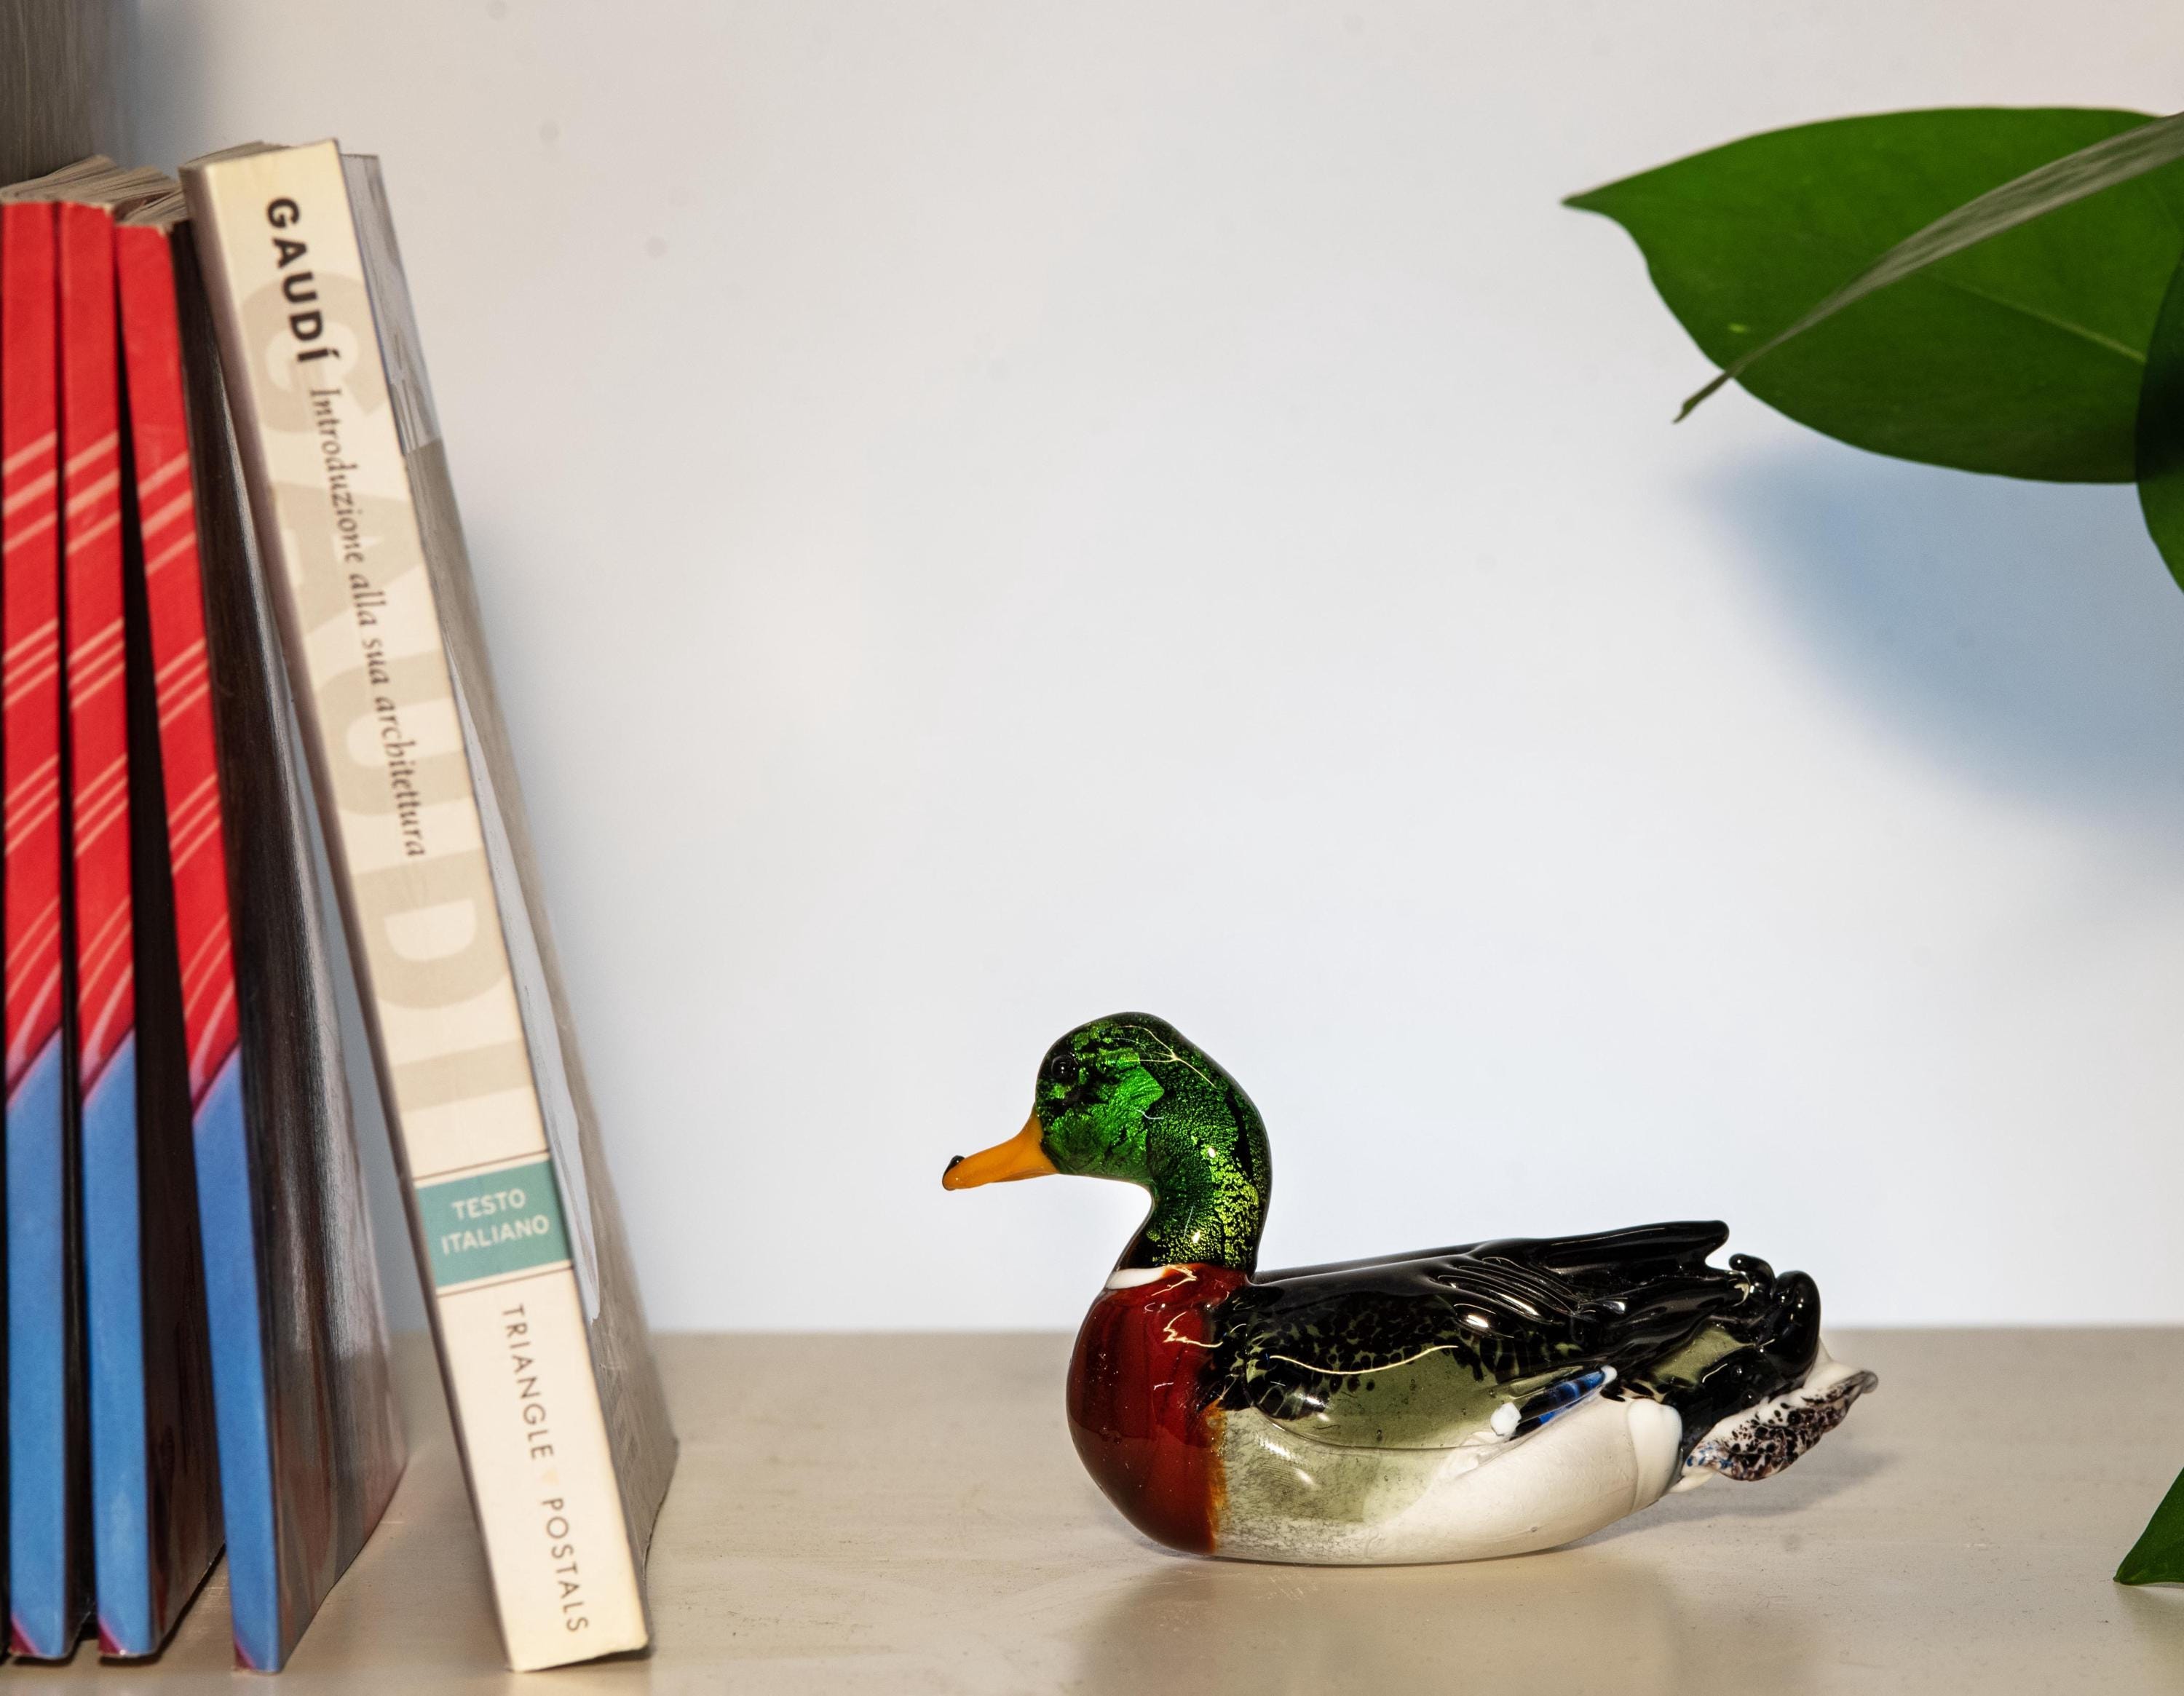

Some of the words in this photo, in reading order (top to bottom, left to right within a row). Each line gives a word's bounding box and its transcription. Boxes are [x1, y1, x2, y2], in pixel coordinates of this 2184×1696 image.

[266, 197, 340, 363] GAUDÍ
[309, 387, 363, 563] Introduzione
[349, 574, 387, 626] alla
[363, 638, 389, 685] sua
[375, 696, 426, 857] architettura
[440, 1214, 550, 1256] ITALIANO
[452, 1188, 526, 1221] TESTO
[502, 1303, 554, 1461] TRIANGLE
[540, 1497, 589, 1633] POSTALS
